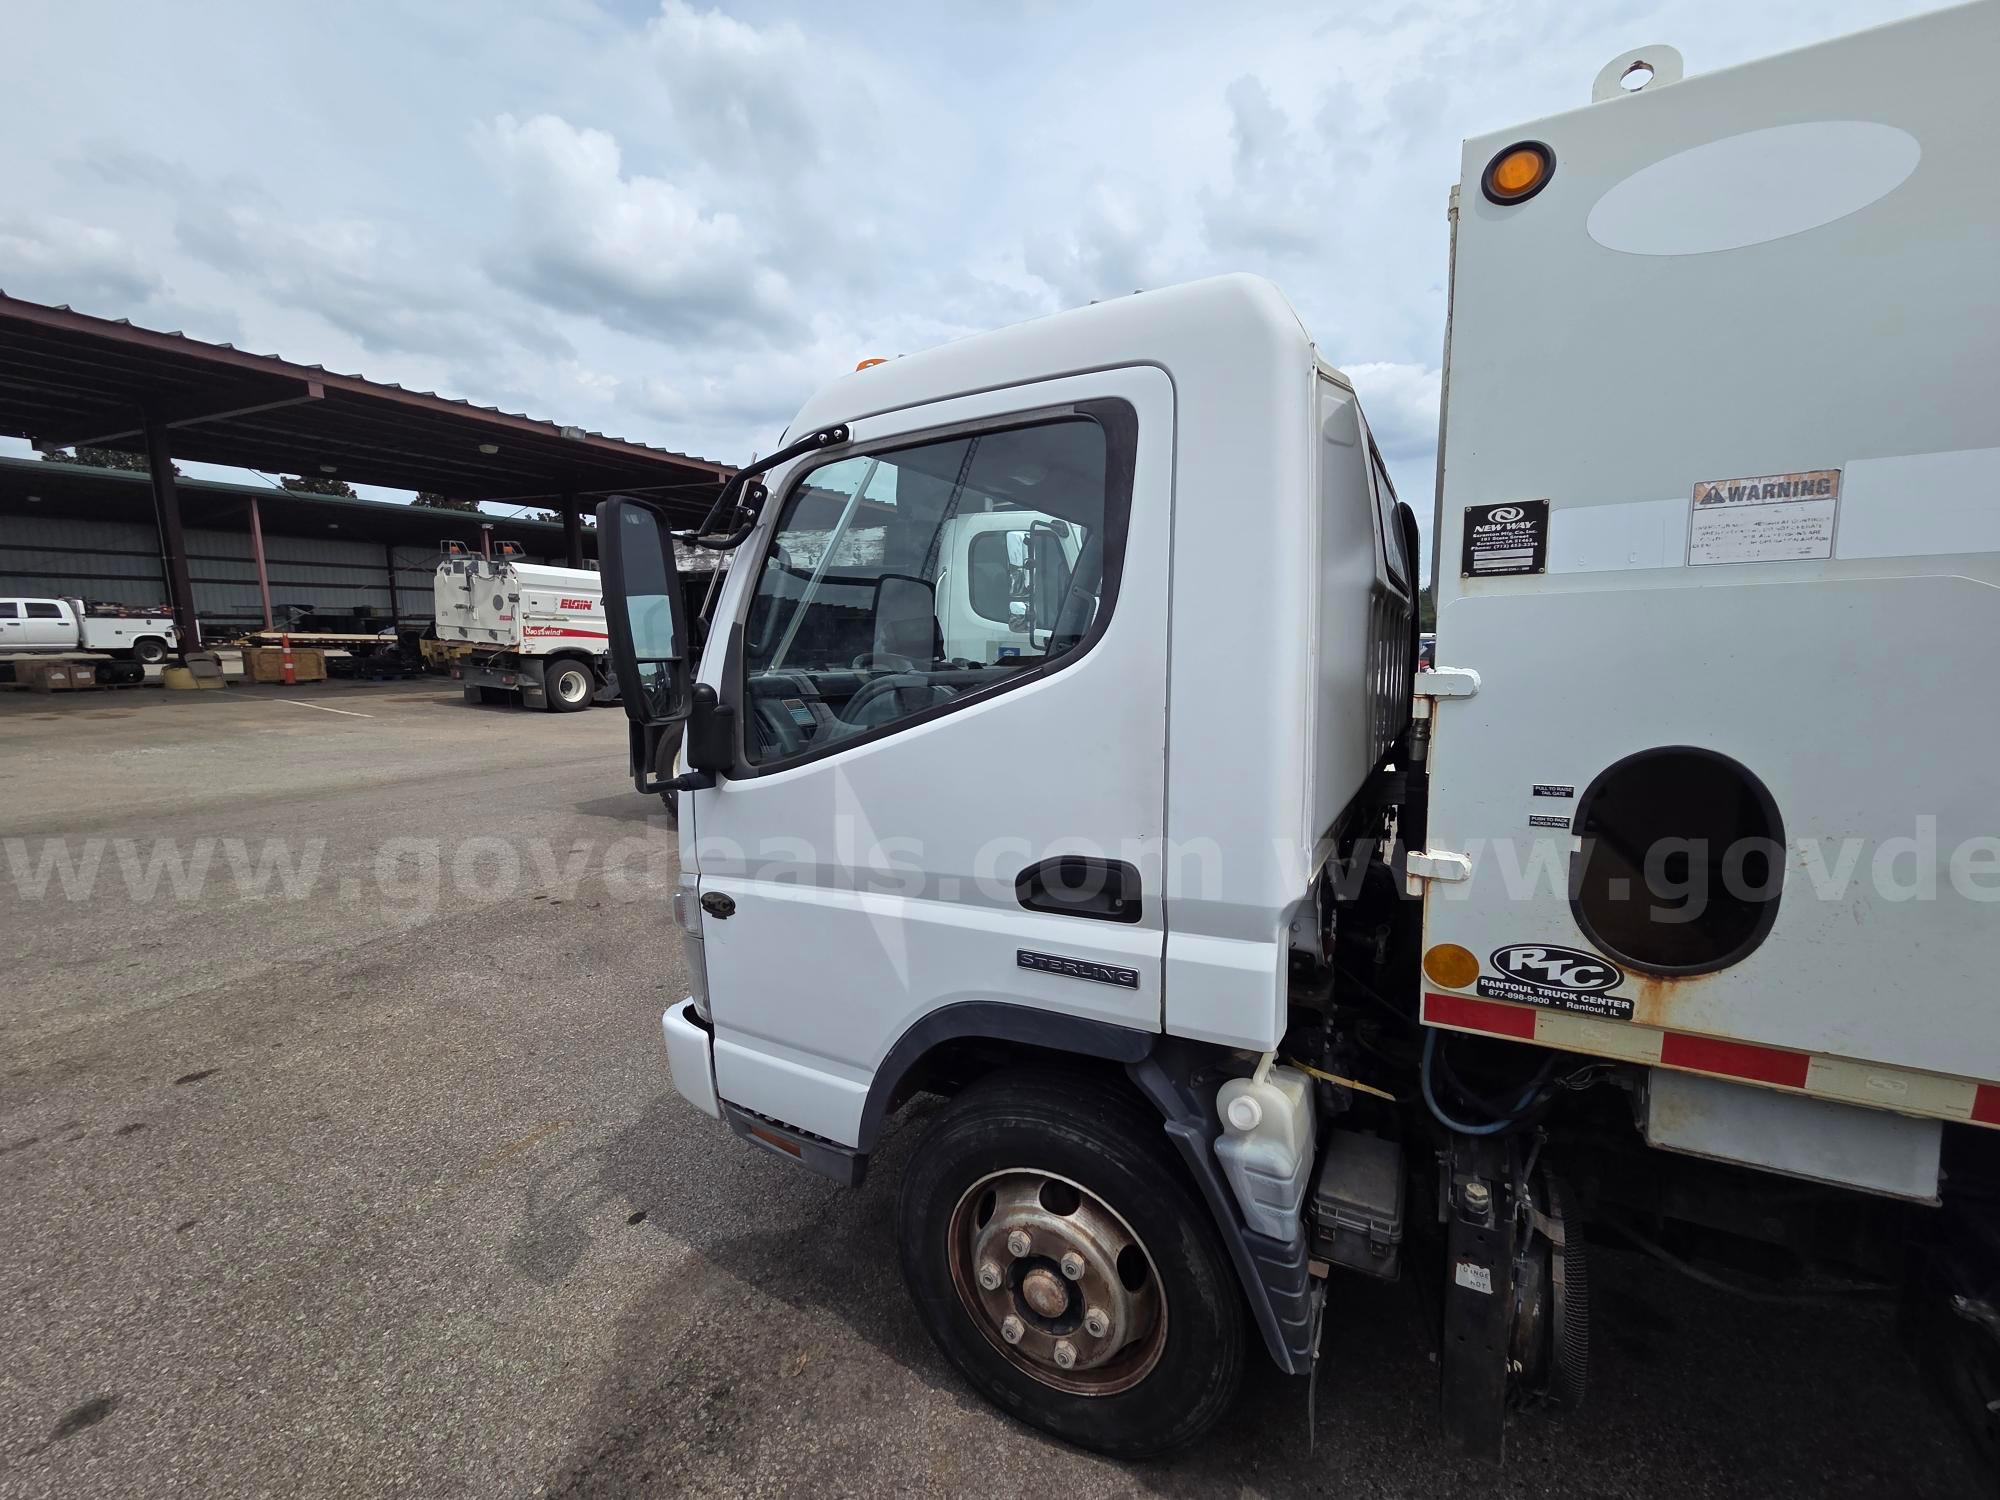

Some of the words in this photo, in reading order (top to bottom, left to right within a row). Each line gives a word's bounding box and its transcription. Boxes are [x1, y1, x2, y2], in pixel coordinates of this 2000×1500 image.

[1727, 478, 1831, 502] WARNING
[1474, 524, 1504, 532] NEW
[1506, 521, 1536, 530] WAY
[560, 598, 593, 610] ELGIN
[1020, 953, 1134, 982] STERLING
[1509, 949, 1604, 987] RTC
[1480, 978, 1534, 994] RANTOUL
[1537, 987, 1578, 1001] TRUCK
[1580, 995, 1630, 1010] CENTER
[1488, 989, 1550, 1005] 877-898-9900
[1566, 1001, 1607, 1015] Rantoul,
[1609, 1008, 1620, 1017] IL
